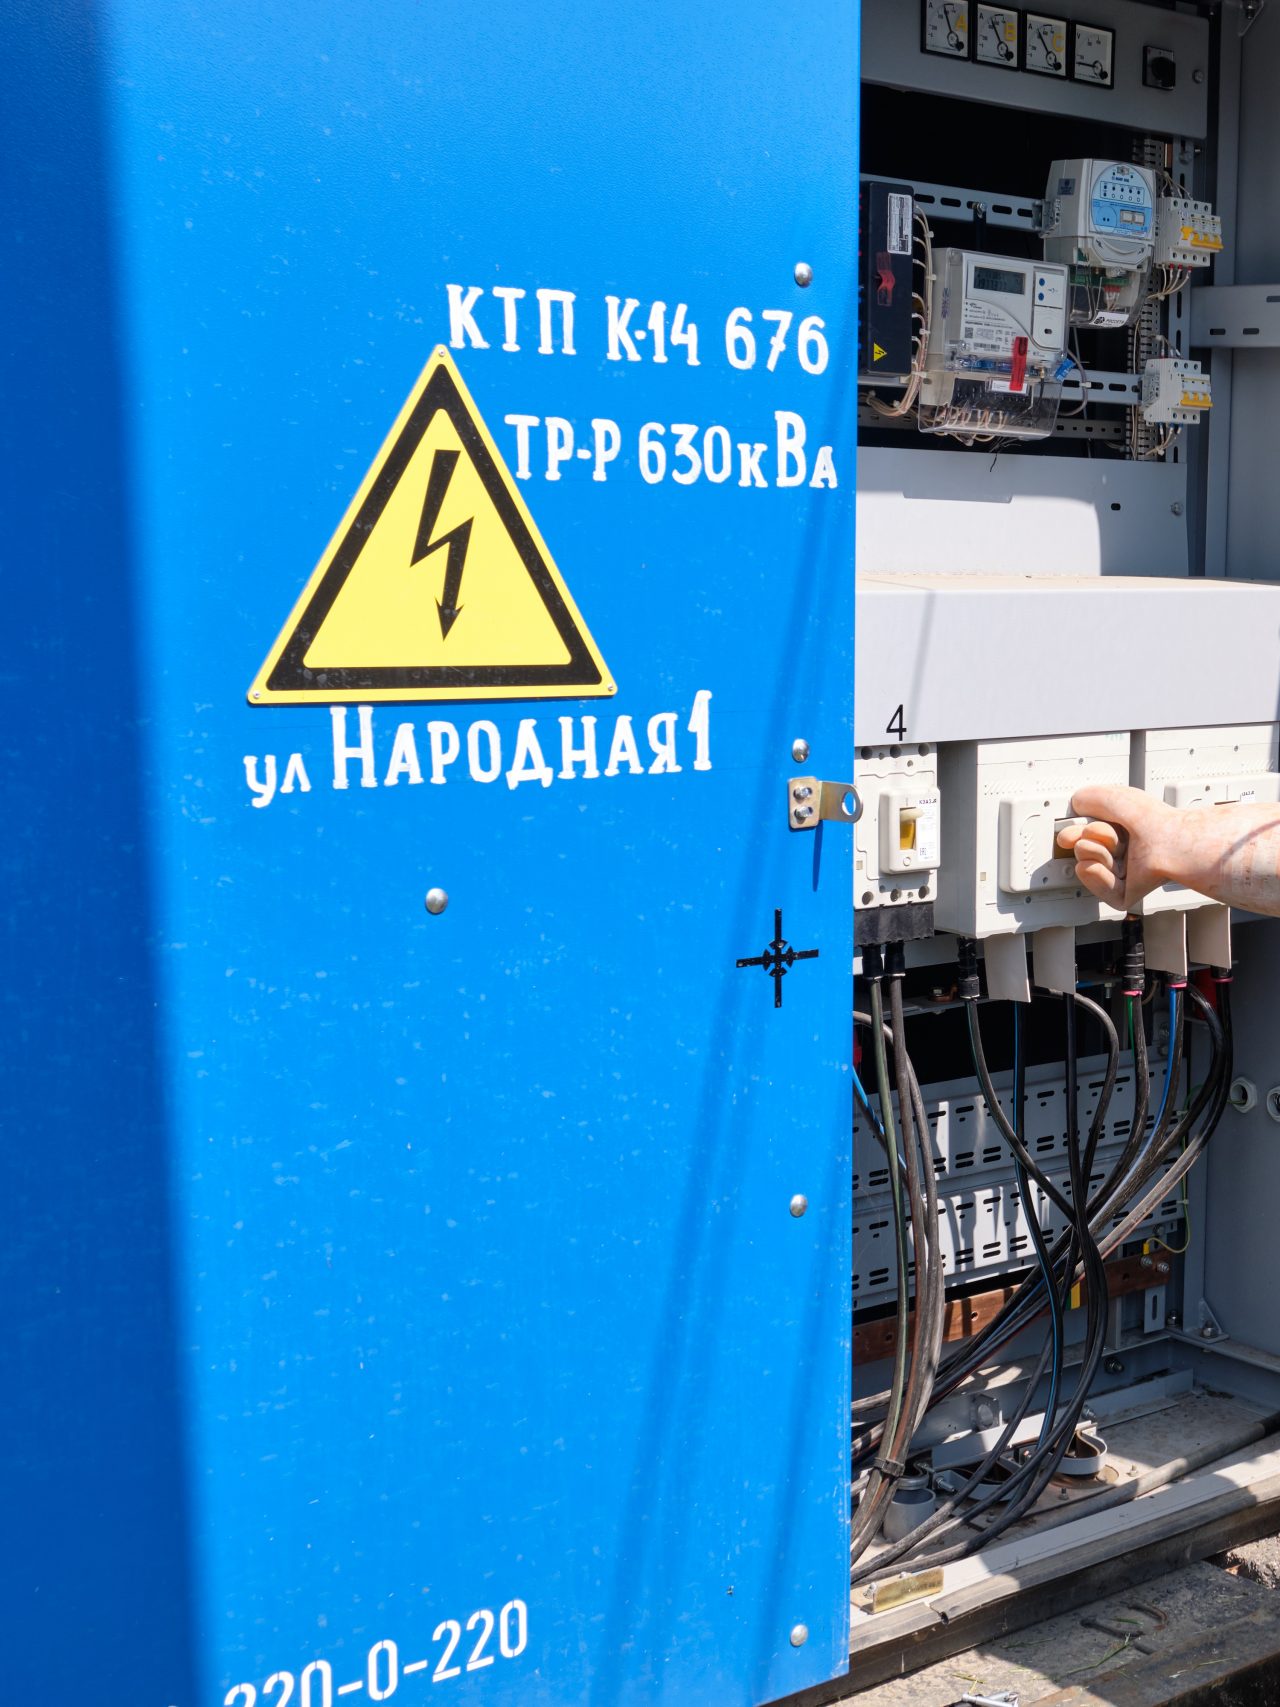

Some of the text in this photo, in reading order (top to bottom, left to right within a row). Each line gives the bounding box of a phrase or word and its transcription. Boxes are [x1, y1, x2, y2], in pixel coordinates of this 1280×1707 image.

[446, 283, 829, 375] КТП К-14 676
[504, 413, 622, 482] ТР-Р
[886, 704, 907, 742] 4
[244, 754, 312, 809] ул
